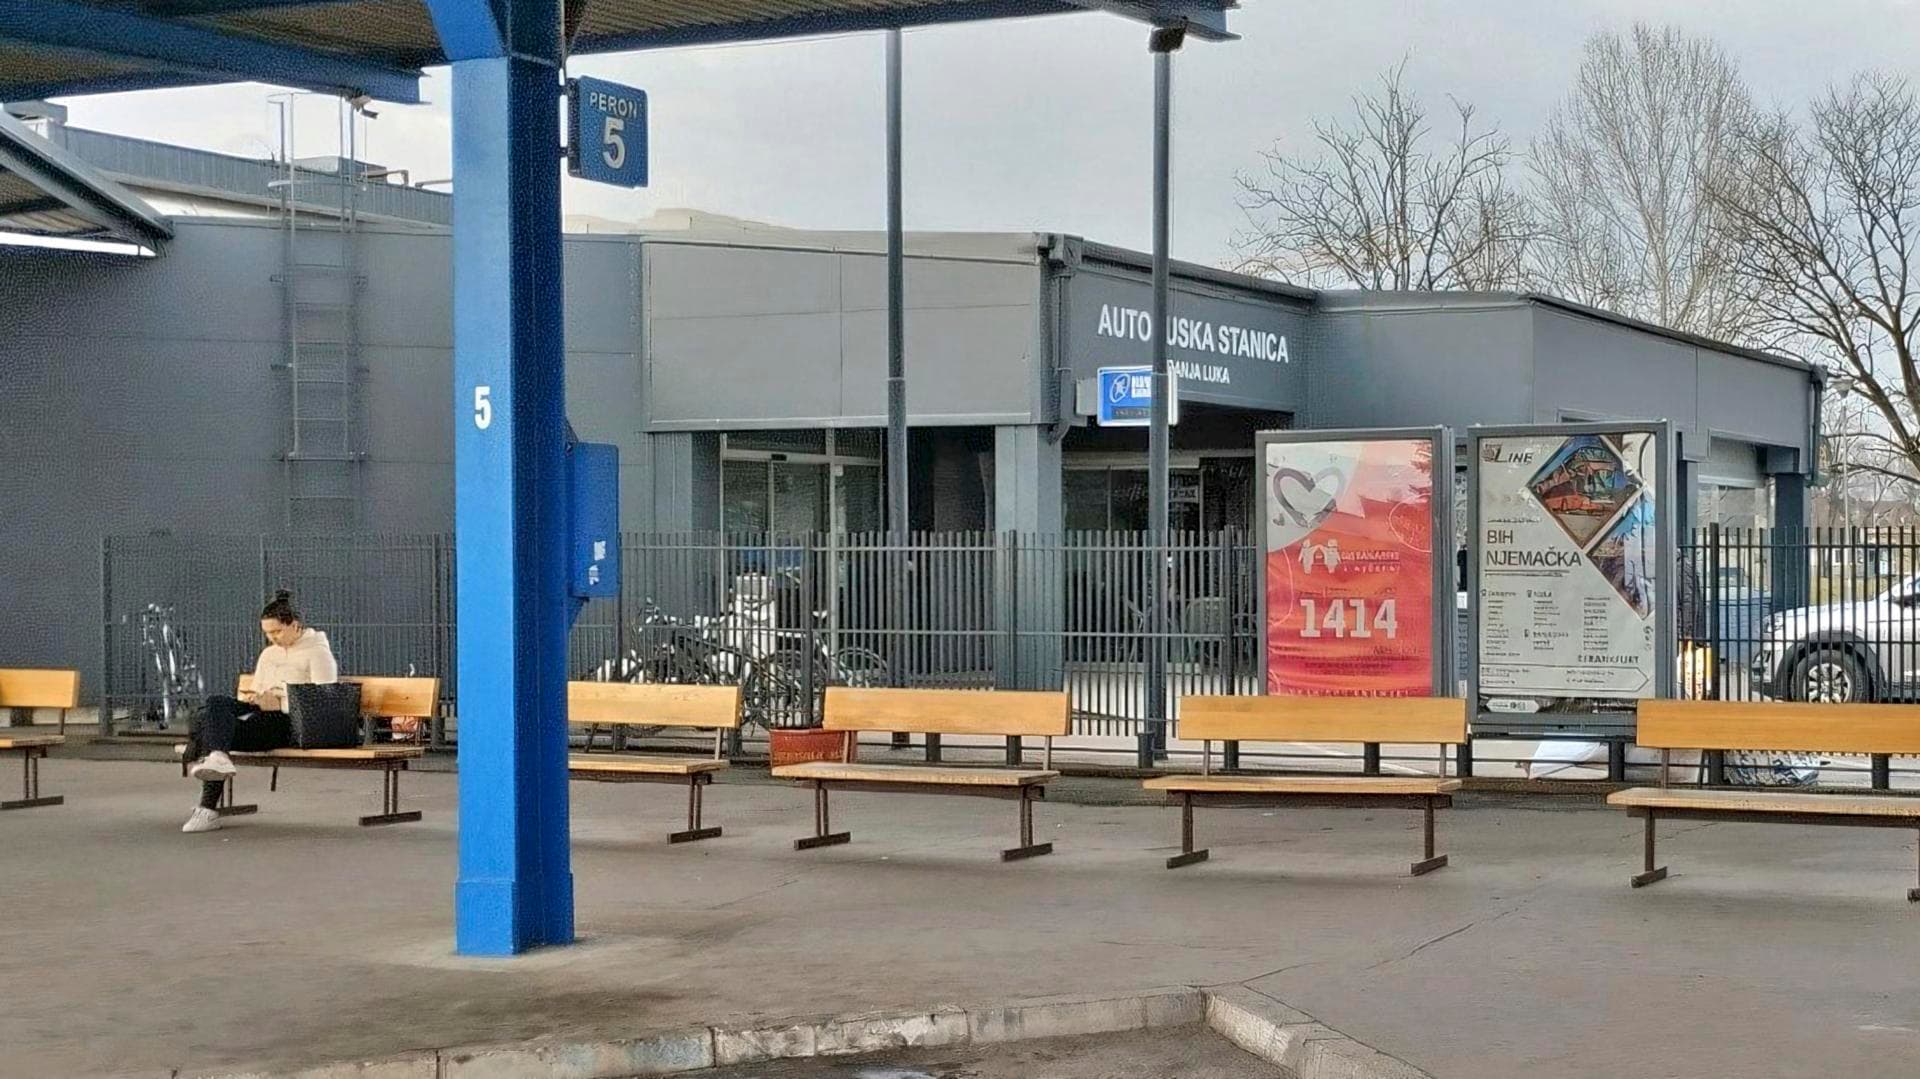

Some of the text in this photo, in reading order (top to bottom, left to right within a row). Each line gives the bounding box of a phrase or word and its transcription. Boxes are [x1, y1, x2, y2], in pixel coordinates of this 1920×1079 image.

[589, 92, 637, 119] PERON
[603, 116, 625, 169] 5
[1098, 304, 1289, 363] AUTOUSKA STANICA
[1203, 364, 1230, 384] LUKA
[475, 386, 491, 429] 5
[1487, 530, 1513, 544] BIH
[1486, 546, 1582, 567] NJEMAČKA
[1300, 599, 1398, 639] 1414
